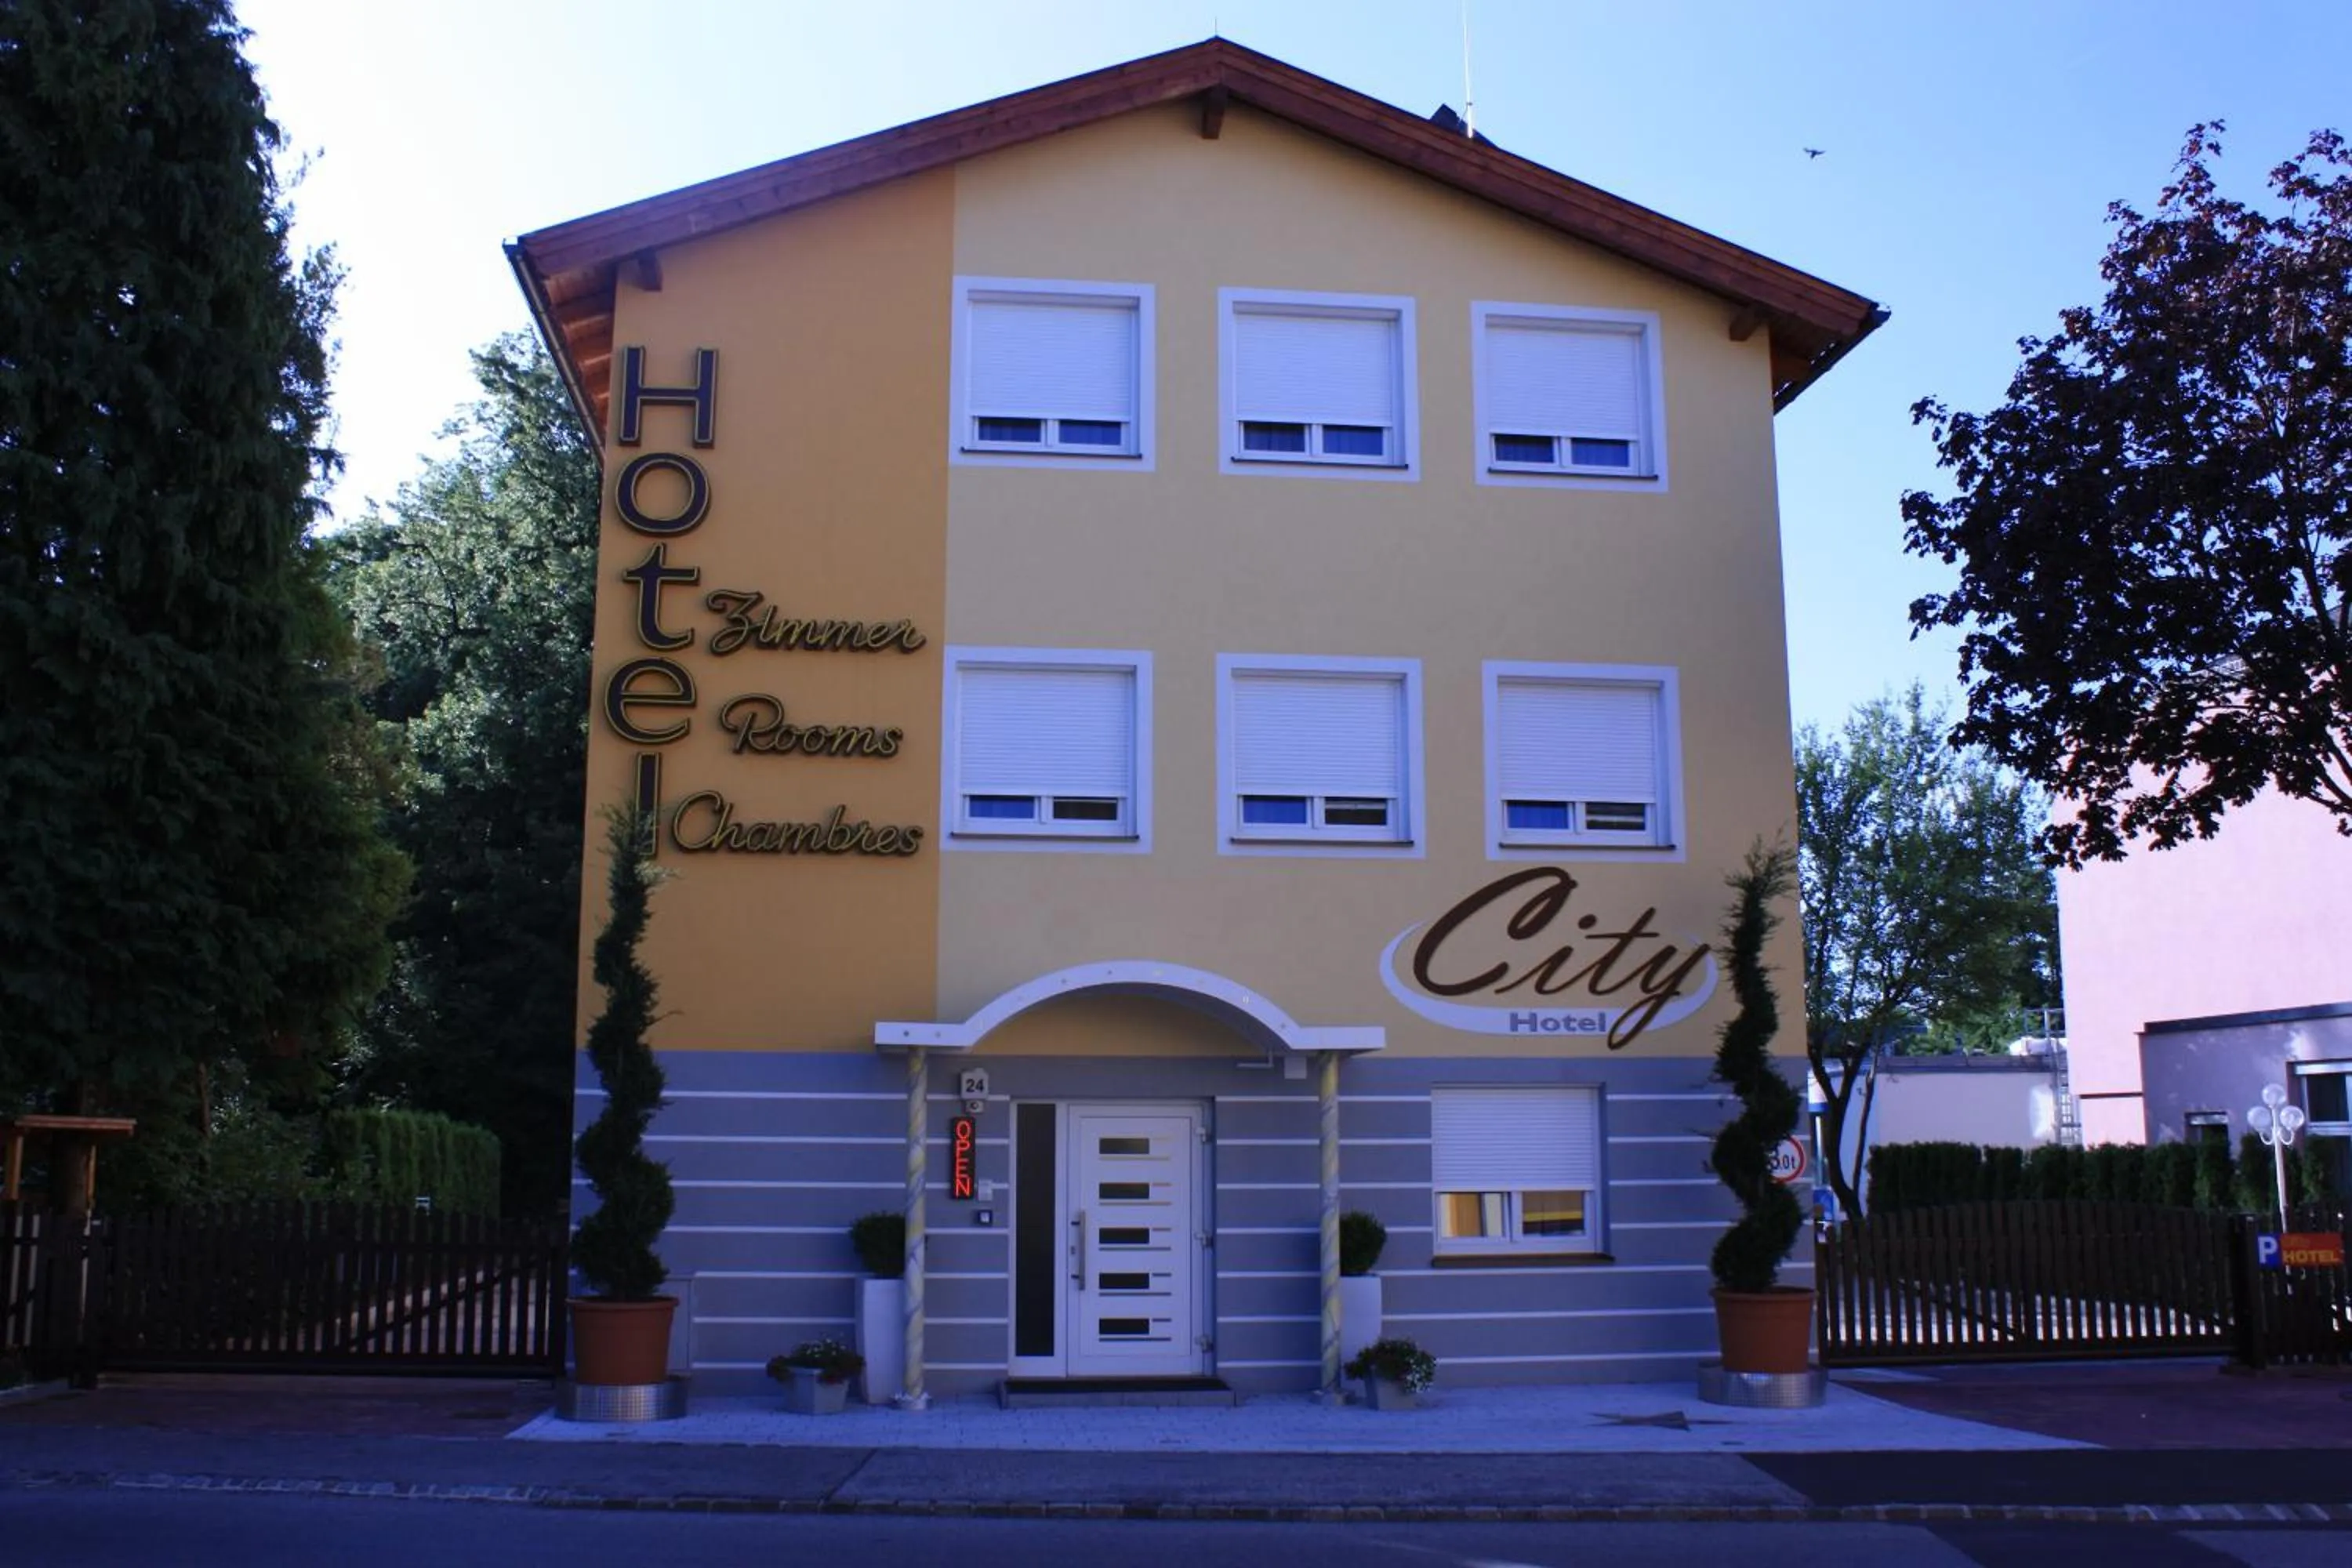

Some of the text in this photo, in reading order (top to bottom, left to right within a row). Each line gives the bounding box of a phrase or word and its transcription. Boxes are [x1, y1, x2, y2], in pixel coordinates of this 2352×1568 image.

[604, 346, 719, 857] Hotel
[706, 589, 927, 655] Zimmer
[720, 694, 903, 757] Rooms
[672, 789, 925, 855] Chambres
[1414, 866, 1711, 1050] City
[1509, 1012, 1606, 1033] Hotel
[965, 1078, 985, 1093] 24
[955, 1120, 972, 1199] OPEN
[2257, 1236, 2278, 1265] P
[2282, 1249, 2339, 1264] HOTEL
